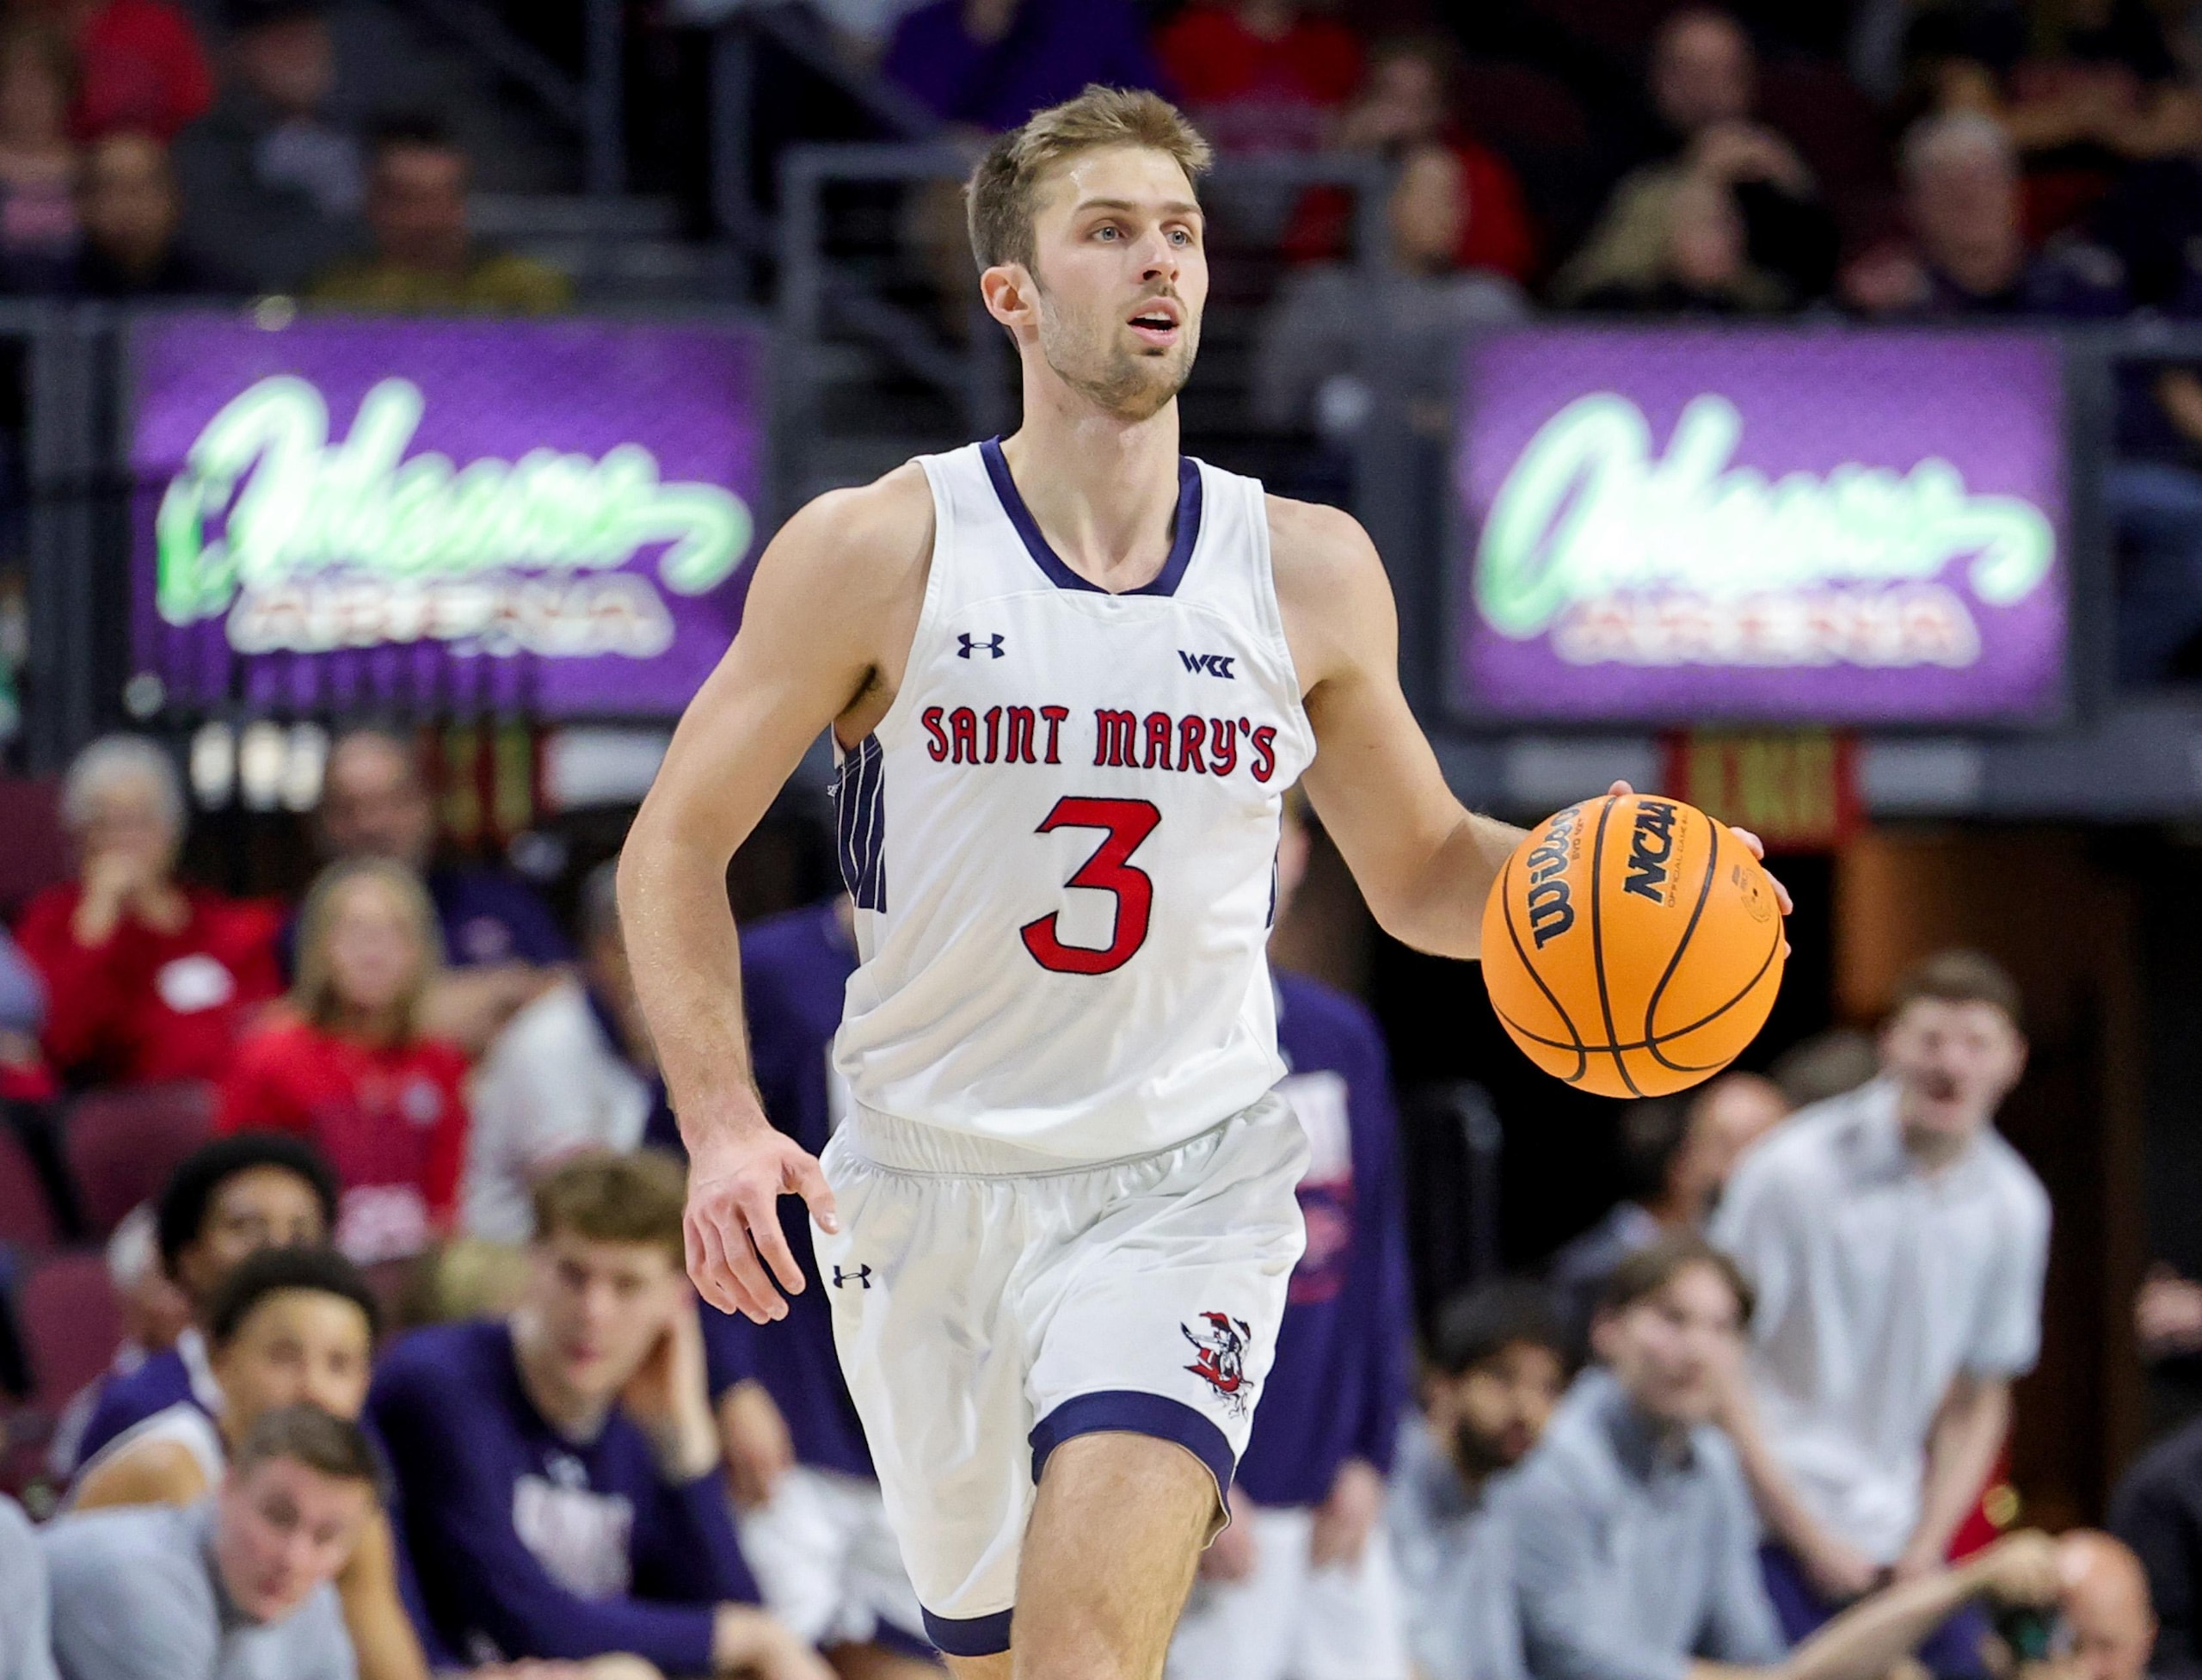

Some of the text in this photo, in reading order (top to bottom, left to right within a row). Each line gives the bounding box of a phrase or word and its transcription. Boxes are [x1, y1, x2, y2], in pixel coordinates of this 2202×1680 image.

[1178, 649, 1236, 680] WCC
[921, 705, 1277, 783] SAINT MARY'S
[1019, 795, 1162, 975] 3
[1526, 805, 1581, 951] Wilso
[1622, 800, 1678, 905] NCAA
